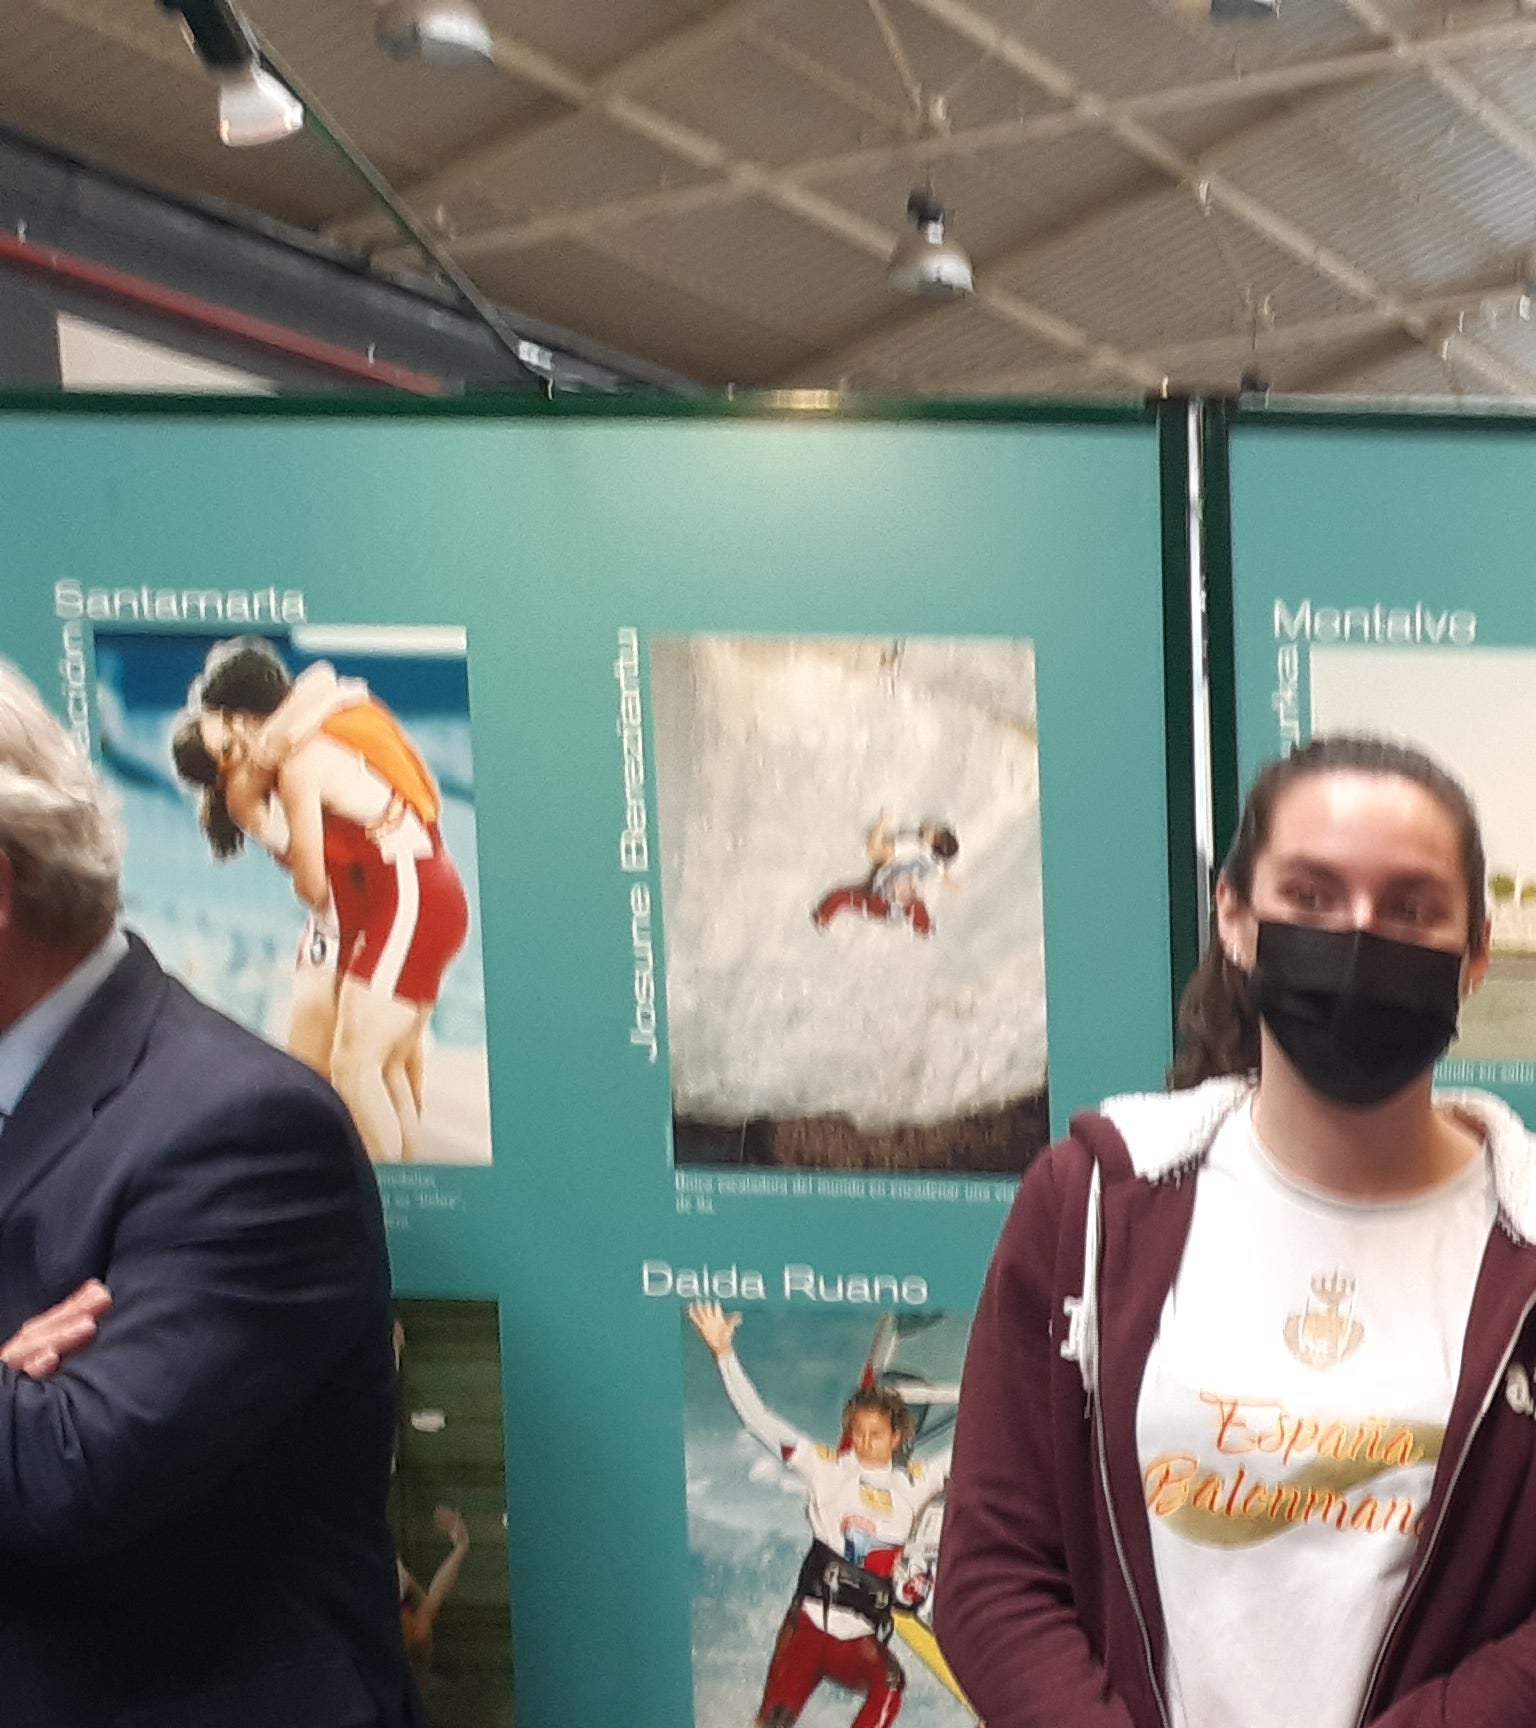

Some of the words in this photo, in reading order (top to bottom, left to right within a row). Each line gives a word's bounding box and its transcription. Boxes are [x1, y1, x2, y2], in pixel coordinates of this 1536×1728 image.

[54, 578, 305, 623] Santamarta
[1271, 597, 1478, 646] Montalvo
[615, 625, 650, 874] Bereziartu
[629, 881, 660, 1065] Josune
[641, 1257, 766, 1300] Daida
[783, 1262, 929, 1306] Ruano
[1199, 1389, 1424, 1467] España
